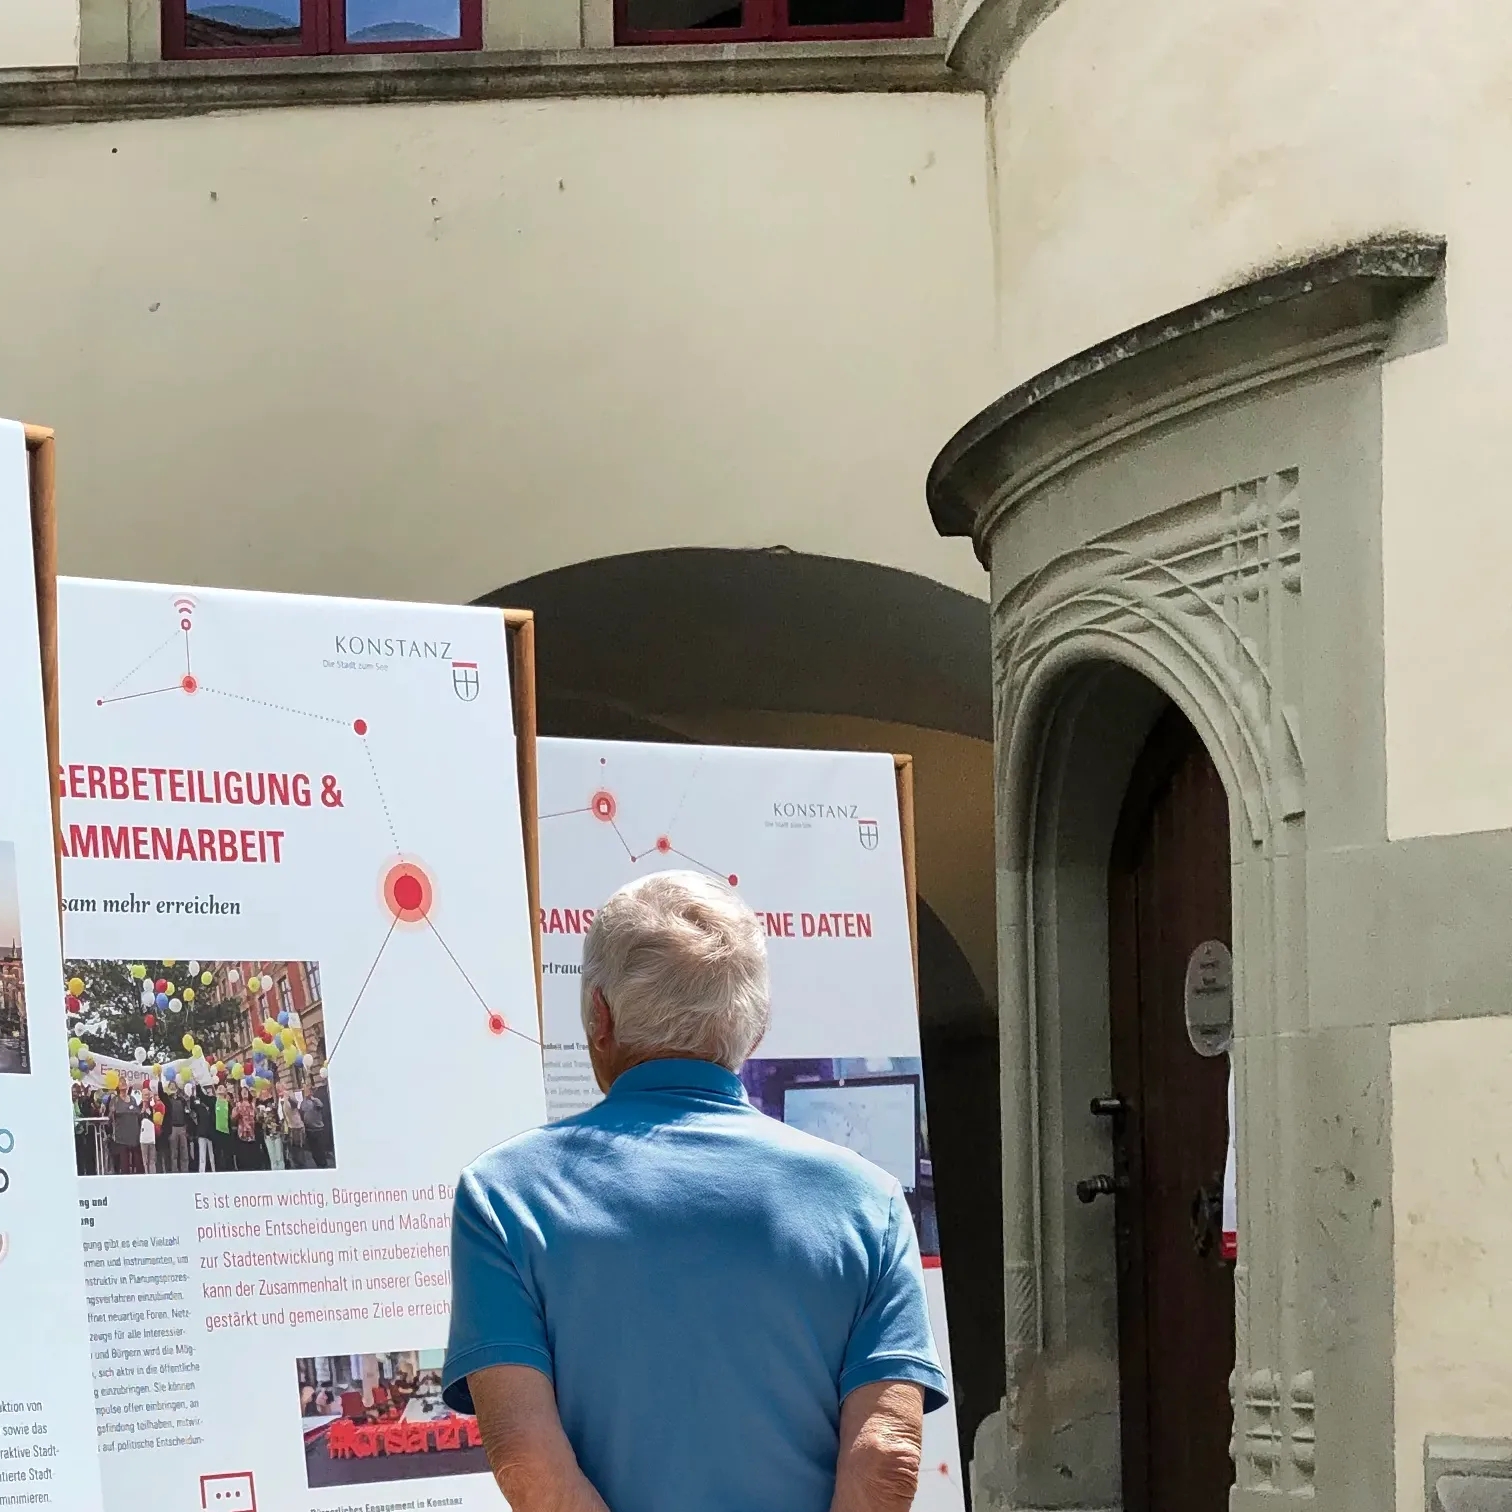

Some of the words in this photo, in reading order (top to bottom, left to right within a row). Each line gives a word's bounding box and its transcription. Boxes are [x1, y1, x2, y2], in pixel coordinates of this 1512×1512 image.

[335, 635, 453, 660] KONSTANZ
[320, 774, 345, 808] &
[774, 802, 859, 819] KONSTANZ
[103, 892, 151, 913] mehr
[156, 894, 241, 915] erreichen
[801, 912, 872, 938] DATEN
[194, 1192, 210, 1210] Es
[213, 1192, 230, 1209] ist
[233, 1194, 274, 1208] enorm
[276, 1189, 328, 1209] wichtig,
[331, 1186, 408, 1208] Bürgerinnen
[412, 1184, 435, 1201] und
[197, 1220, 261, 1243] politische
[265, 1217, 368, 1237] Entscheidungen
[371, 1214, 395, 1232] und
[200, 1255, 219, 1269] zur
[222, 1247, 334, 1268] Stadtentwicklung
[338, 1245, 359, 1262] mit
[202, 1282, 232, 1299] kann
[235, 1280, 256, 1297] der
[258, 1275, 349, 1296] Zusammenhalt
[351, 1278, 363, 1291] in
[365, 1276, 410, 1290] unserer
[205, 1309, 259, 1333] gestärkt
[261, 1307, 285, 1326] und
[289, 1307, 369, 1328] gemeinsame
[372, 1301, 404, 1319] Ziele
[416, 1500, 425, 1509] in
[426, 1497, 463, 1508] Konstanz
